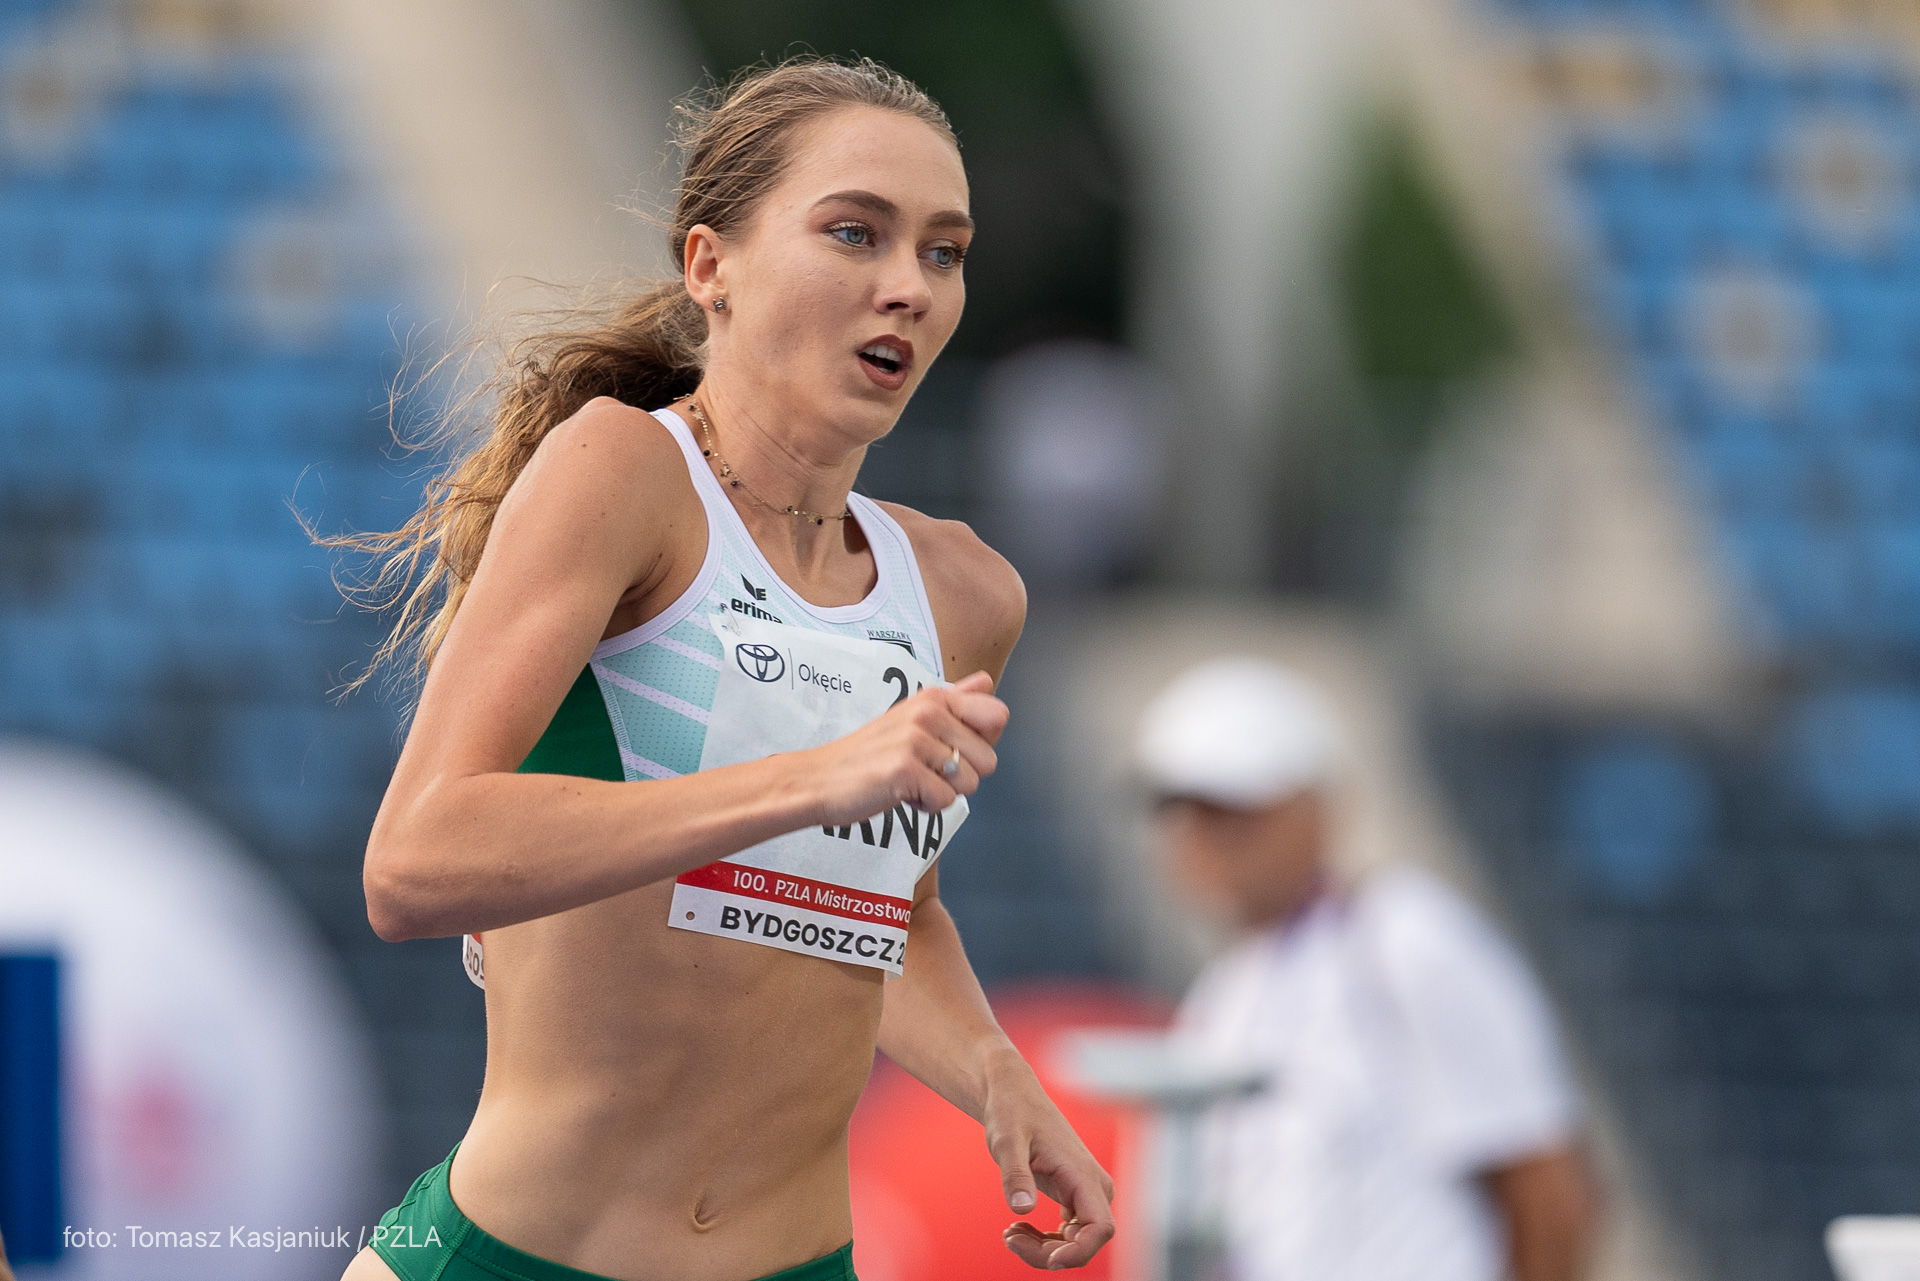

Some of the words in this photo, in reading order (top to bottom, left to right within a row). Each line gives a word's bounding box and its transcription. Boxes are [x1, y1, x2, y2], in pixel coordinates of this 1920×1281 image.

[798, 663, 852, 693] Okęcie
[733, 869, 769, 893] 100.
[774, 879, 811, 903] PZLA
[720, 905, 896, 963] BYDGOSZCZ
